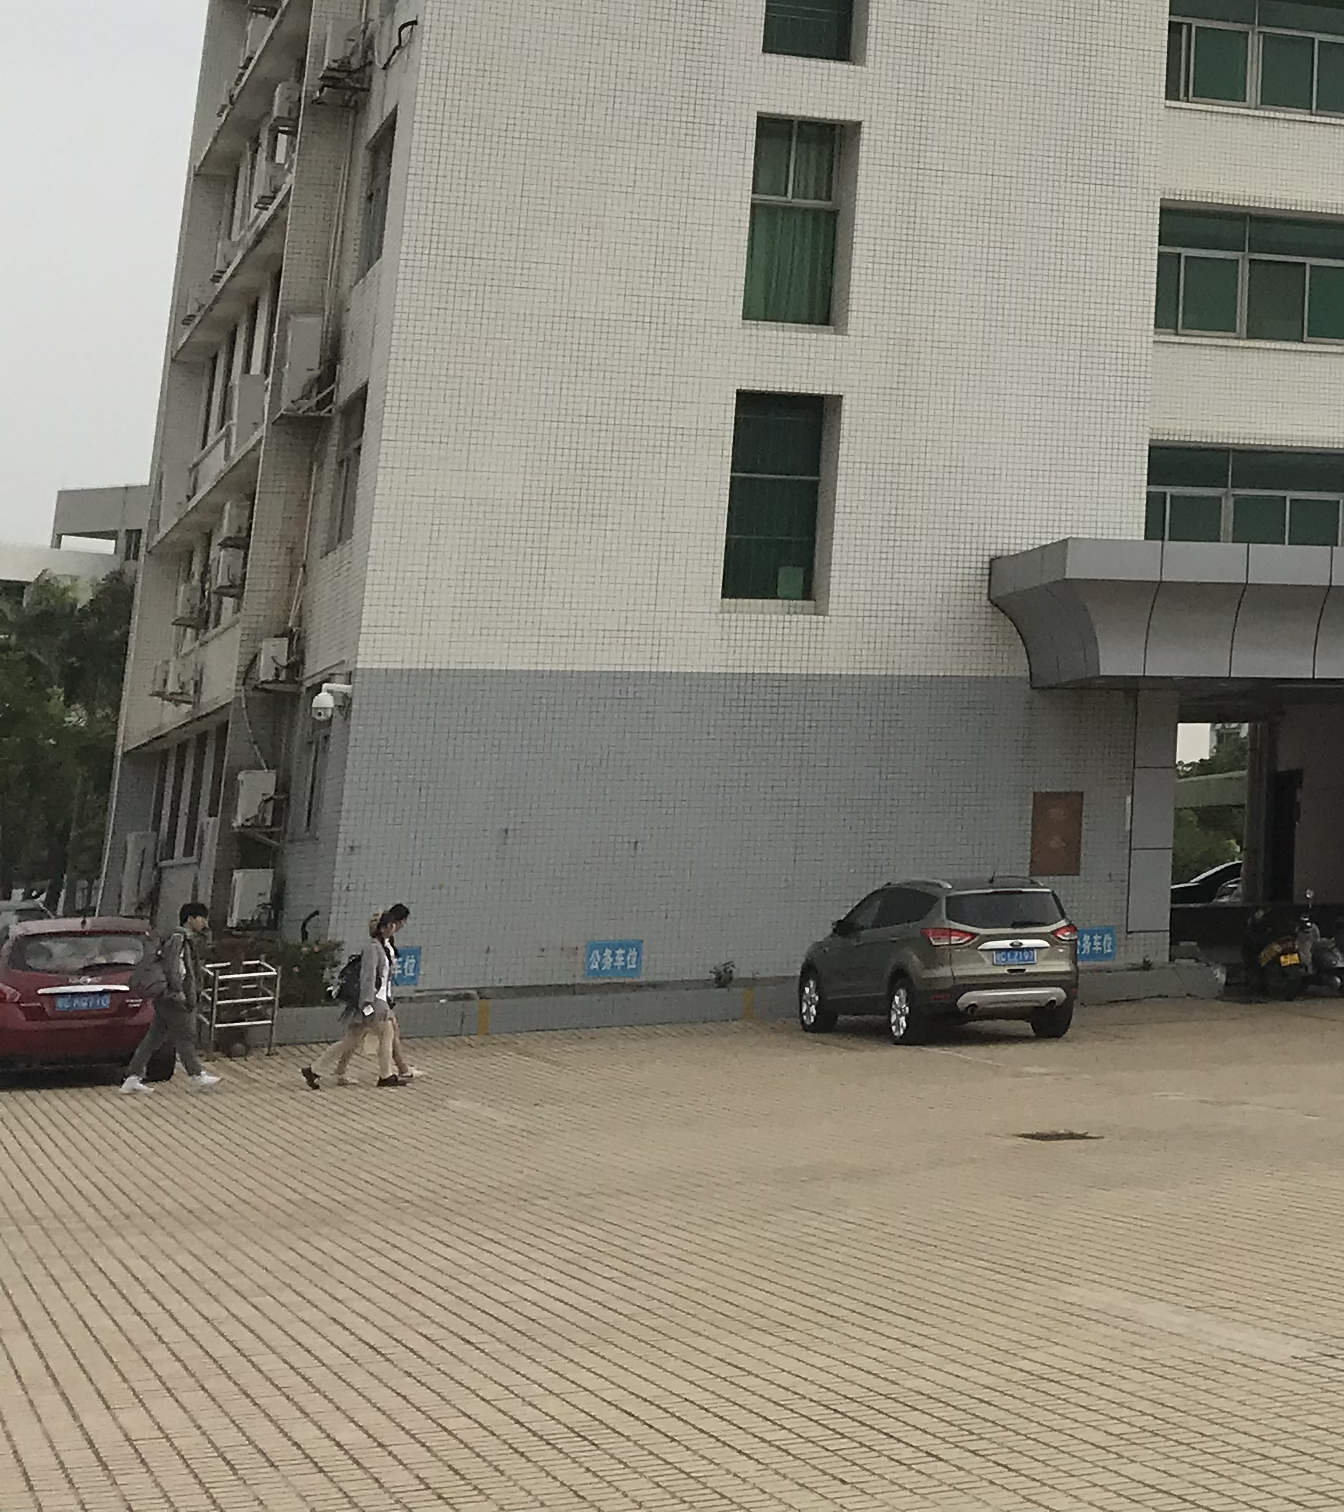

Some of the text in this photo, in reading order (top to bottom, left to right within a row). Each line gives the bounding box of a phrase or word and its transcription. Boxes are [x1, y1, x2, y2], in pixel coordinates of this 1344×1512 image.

[1077, 933, 1113, 955] 务车位
[392, 954, 417, 978] 车位
[588, 947, 638, 970] 公务车位
